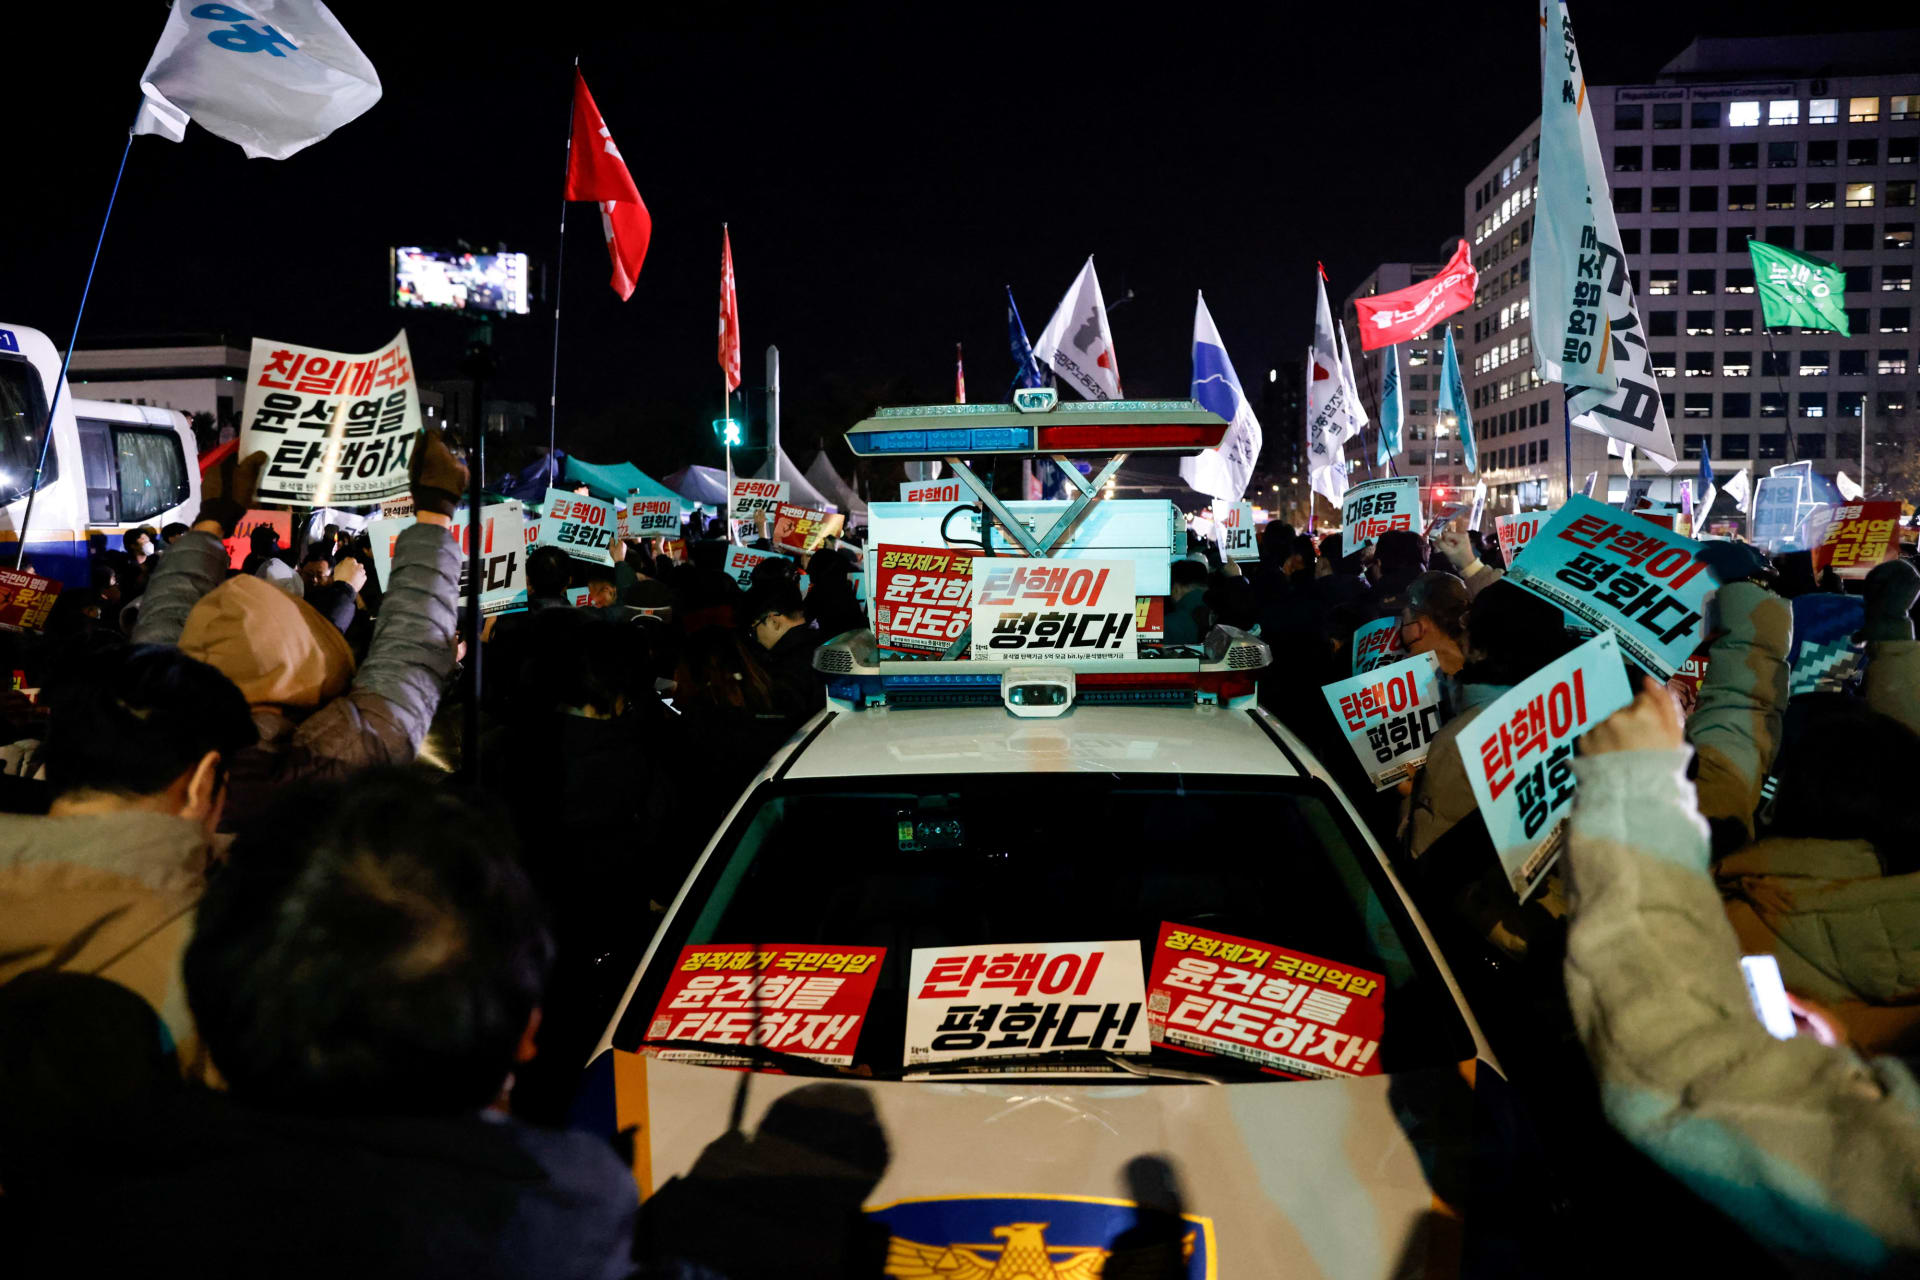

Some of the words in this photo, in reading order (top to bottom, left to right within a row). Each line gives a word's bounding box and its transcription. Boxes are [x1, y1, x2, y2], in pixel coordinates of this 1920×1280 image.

[250, 388, 408, 439] 윤석열을
[732, 481, 781, 498] 탄핵이
[549, 498, 607, 527] 탄핵이
[632, 501, 672, 517] 탄핵이
[640, 515, 678, 530] 평화다
[779, 505, 807, 518] 국민의
[805, 510, 825, 522] 명령
[1345, 491, 1398, 527] 평화다
[1352, 512, 1412, 545] 탄핵이
[1823, 518, 1896, 546] 윤석열
[881, 551, 951, 573] 정적제거
[1557, 513, 1709, 591] 탄핵이
[1830, 541, 1889, 567] 탄핵
[883, 573, 973, 609] 윤건희
[977, 566, 1111, 607] 탄핵이
[1555, 550, 1703, 646] 평화다
[988, 611, 1134, 649] 평화다!
[1339, 670, 1420, 733] 탄핵이
[1479, 667, 1588, 802] 탄핵이
[679, 951, 778, 972] 정적제거
[776, 951, 877, 974] 국민억압
[916, 951, 1105, 1000] 탄핵이
[1164, 930, 1272, 969] 정적제거
[1271, 954, 1378, 998] 국민억압
[667, 974, 847, 1011] 윤건희를
[1161, 956, 1353, 1027] 윤건희를
[666, 1011, 861, 1051] 타도하자!
[930, 1001, 1143, 1052] 평화다!
[1166, 993, 1380, 1072] 타도하자!
